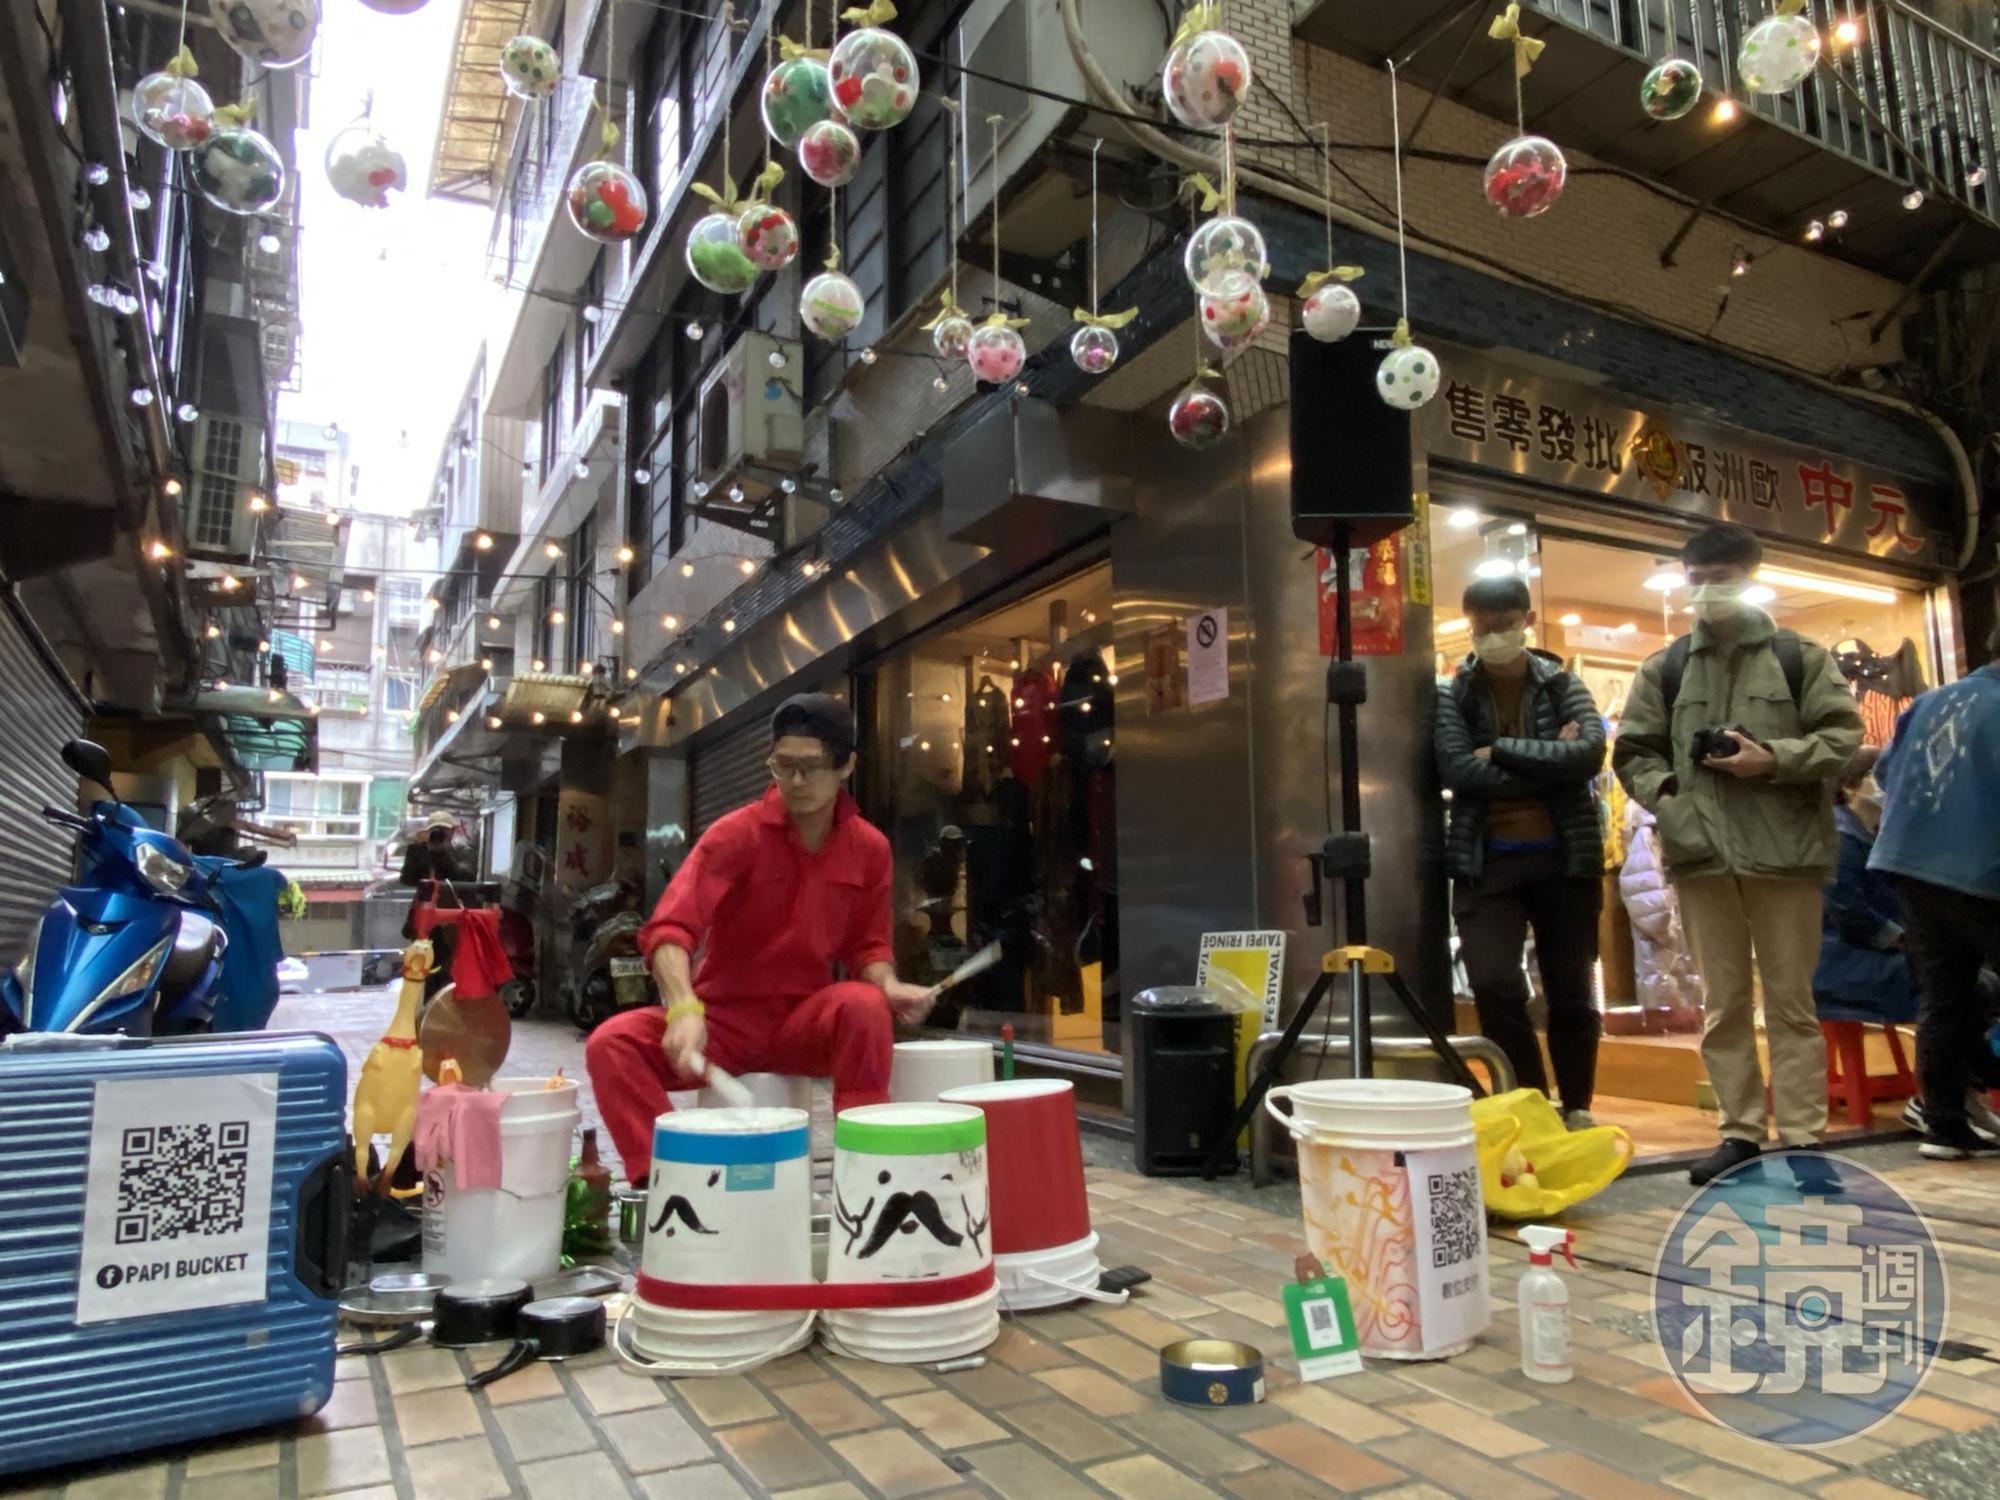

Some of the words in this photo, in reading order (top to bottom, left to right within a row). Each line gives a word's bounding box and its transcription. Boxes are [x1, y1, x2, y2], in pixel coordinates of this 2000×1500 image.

[1444, 379, 1783, 513] 歐洲服批發零售
[1203, 934, 1243, 948] FRINGE
[1245, 933, 1282, 946] TAIPEI
[125, 1263, 170, 1284] PAPI
[177, 1253, 249, 1279] BUCKET
